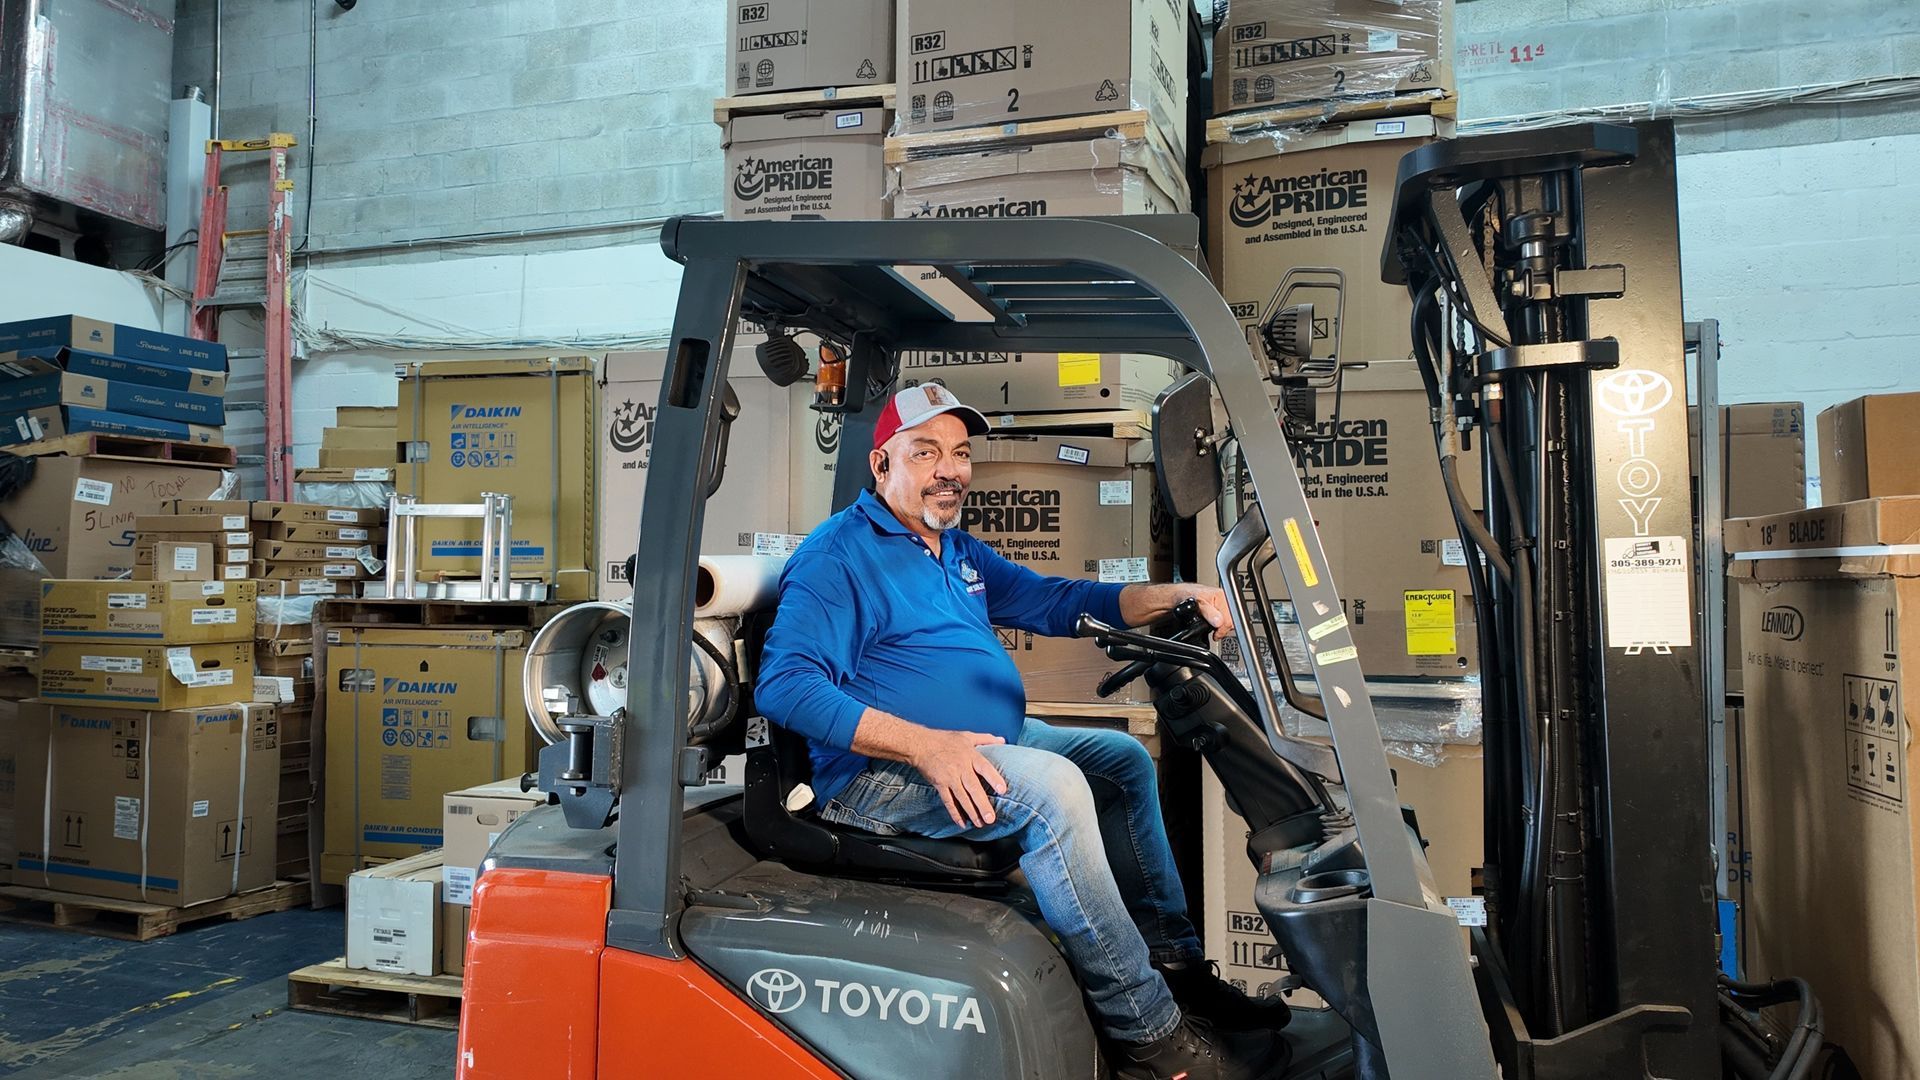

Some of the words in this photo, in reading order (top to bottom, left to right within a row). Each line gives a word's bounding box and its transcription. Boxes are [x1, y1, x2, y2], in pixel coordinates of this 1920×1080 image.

[742, 5, 765, 22] R32
[1236, 24, 1263, 42] R32
[914, 34, 942, 50] R32
[1333, 71, 1346, 92] 2
[1007, 88, 1019, 113] 2
[754, 154, 833, 174] American
[764, 170, 832, 193] PRIDE
[1257, 167, 1368, 195] American
[764, 195, 794, 204] Designed,
[795, 193, 832, 203] Engineered
[1272, 184, 1367, 217] PRIDE
[744, 207, 756, 215] and
[757, 204, 791, 213] Assembled
[800, 203, 810, 211] the
[812, 202, 832, 210] U.S.A.
[935, 198, 1047, 218] American
[1272, 219, 1315, 231] Designed,
[1317, 212, 1368, 225] Engineered
[1245, 234, 1262, 244] and
[1263, 230, 1311, 242] Assembled
[1313, 228, 1322, 237] in
[1324, 226, 1339, 236] the
[1341, 223, 1368, 234] U.S.A.
[920, 271, 937, 281] and
[179, 349, 193, 357] LINE
[194, 351, 209, 359] SETS
[1000, 381, 1009, 404] 1
[190, 403, 206, 412] SETS
[464, 406, 522, 419] DAIKIN
[1305, 415, 1388, 438] erican
[622, 460, 636, 469] and
[119, 475, 136, 495] NO
[1326, 472, 1389, 486] Engineered
[962, 484, 1060, 507] merican
[1321, 485, 1332, 498] in
[1335, 484, 1353, 498] the
[1355, 485, 1389, 498] U.S.A.
[84, 510, 97, 531] 5
[960, 507, 1060, 532] PRIDE
[1760, 524, 1777, 546] 18"
[1788, 519, 1825, 544] BLADE
[1007, 538, 1060, 550] Engineered
[1014, 551, 1029, 561] the
[1032, 551, 1060, 561] U.S.A.
[1611, 558, 1682, 568] 305-389-9271
[611, 564, 627, 580] R3
[1761, 611, 1796, 636] LENNOX
[1885, 662, 1896, 672] UP
[397, 681, 458, 695] DAIKIN
[70, 718, 112, 730] DAIKIN
[205, 713, 239, 724] DAIKIN
[1886, 751, 1892, 761] 5
[363, 824, 388, 832] DAIKIN
[1232, 914, 1264, 932] R32
[814, 979, 986, 1034] TOYOTA
